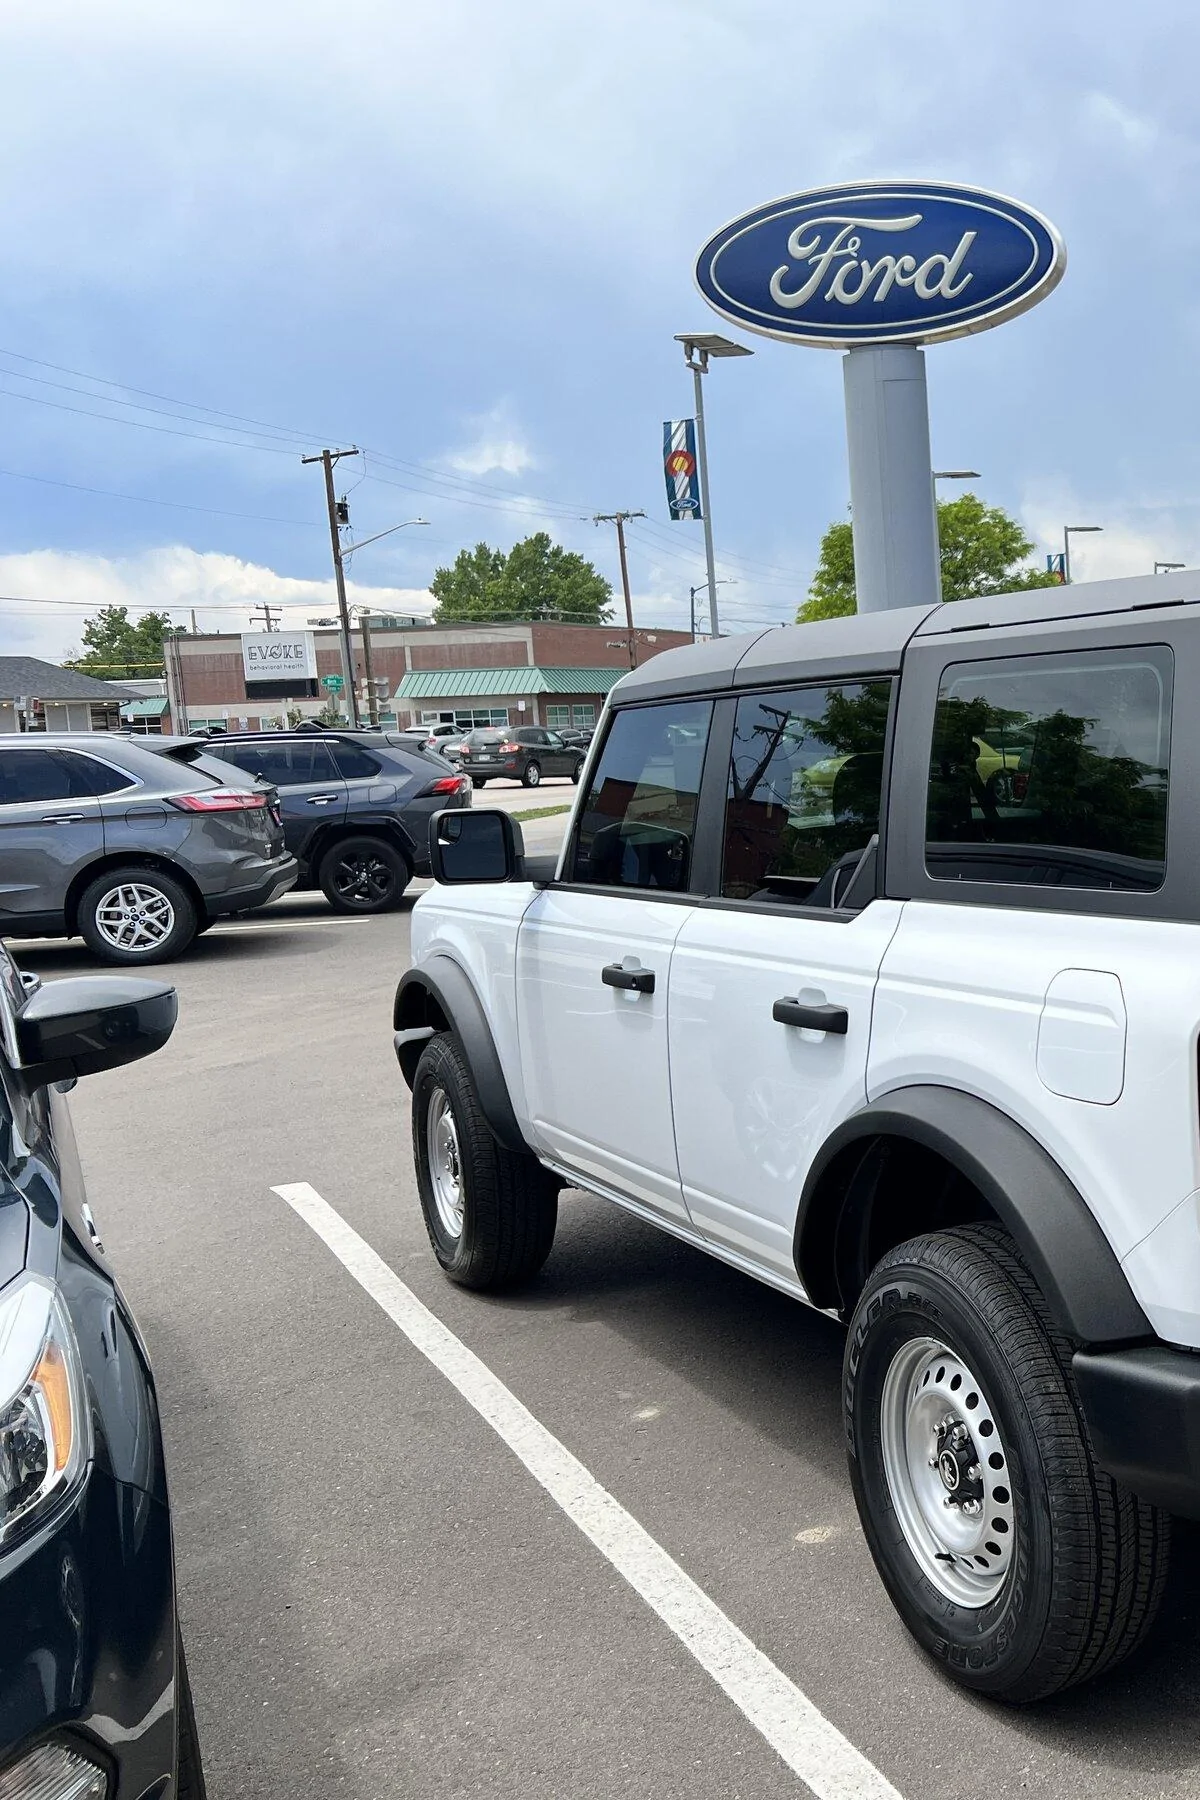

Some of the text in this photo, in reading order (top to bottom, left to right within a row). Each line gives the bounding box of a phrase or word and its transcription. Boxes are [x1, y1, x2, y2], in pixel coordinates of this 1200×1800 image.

[769, 213, 977, 309] Ford
[247, 643, 303, 660] EVOKE
[250, 662, 304, 671] behavioral health
